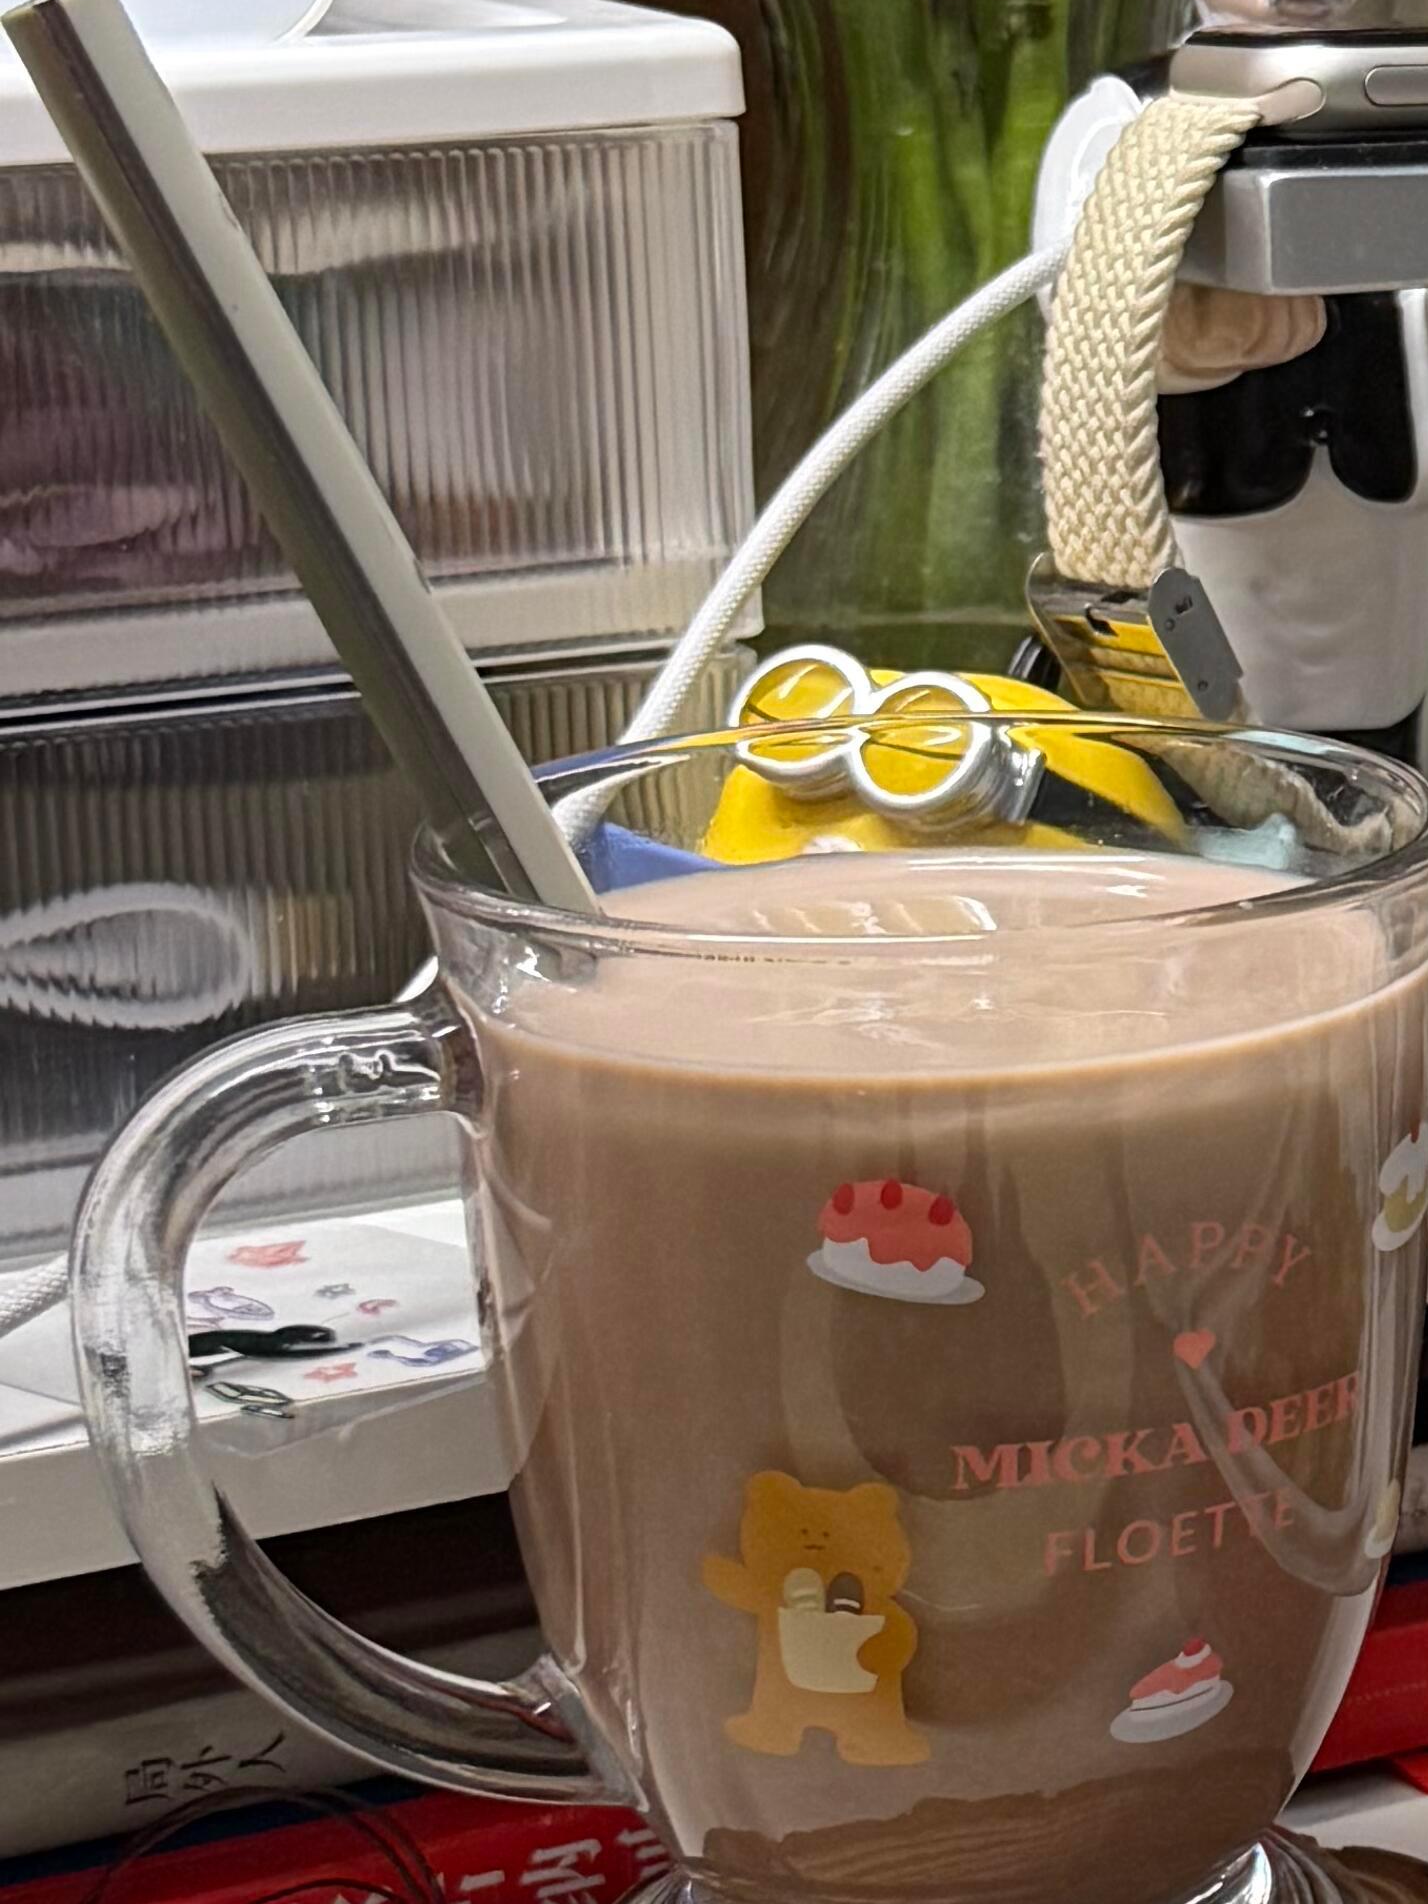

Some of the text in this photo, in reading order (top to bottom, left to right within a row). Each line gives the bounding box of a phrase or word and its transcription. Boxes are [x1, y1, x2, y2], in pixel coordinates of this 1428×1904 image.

[1061, 1219, 1313, 1319] HAPPY
[950, 1421, 1211, 1492] MICKA
[1045, 1486, 1298, 1576] FLOETTE
[125, 1730, 289, 1806] 局外人
